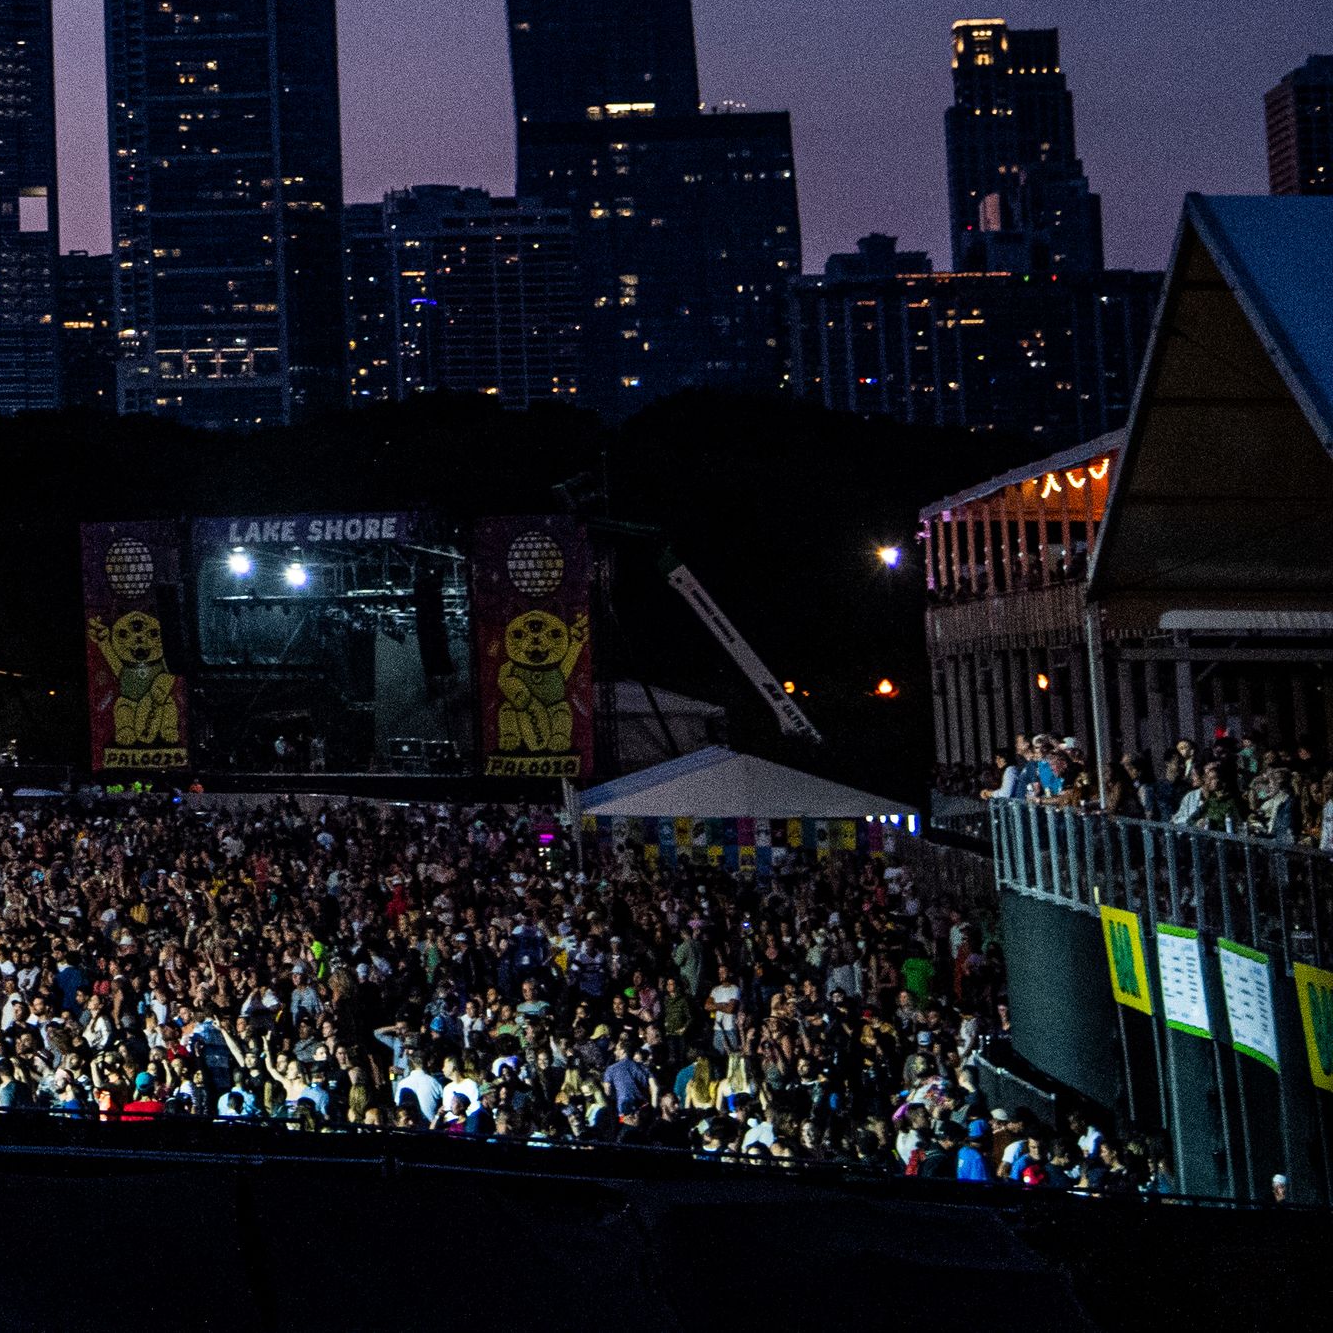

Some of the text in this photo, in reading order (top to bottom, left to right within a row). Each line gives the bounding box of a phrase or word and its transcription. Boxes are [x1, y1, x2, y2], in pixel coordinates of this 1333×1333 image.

[229, 517, 397, 543] LAKE SHORE
[106, 752, 185, 766] PALOOZA
[490, 759, 577, 775] PALOOZA
